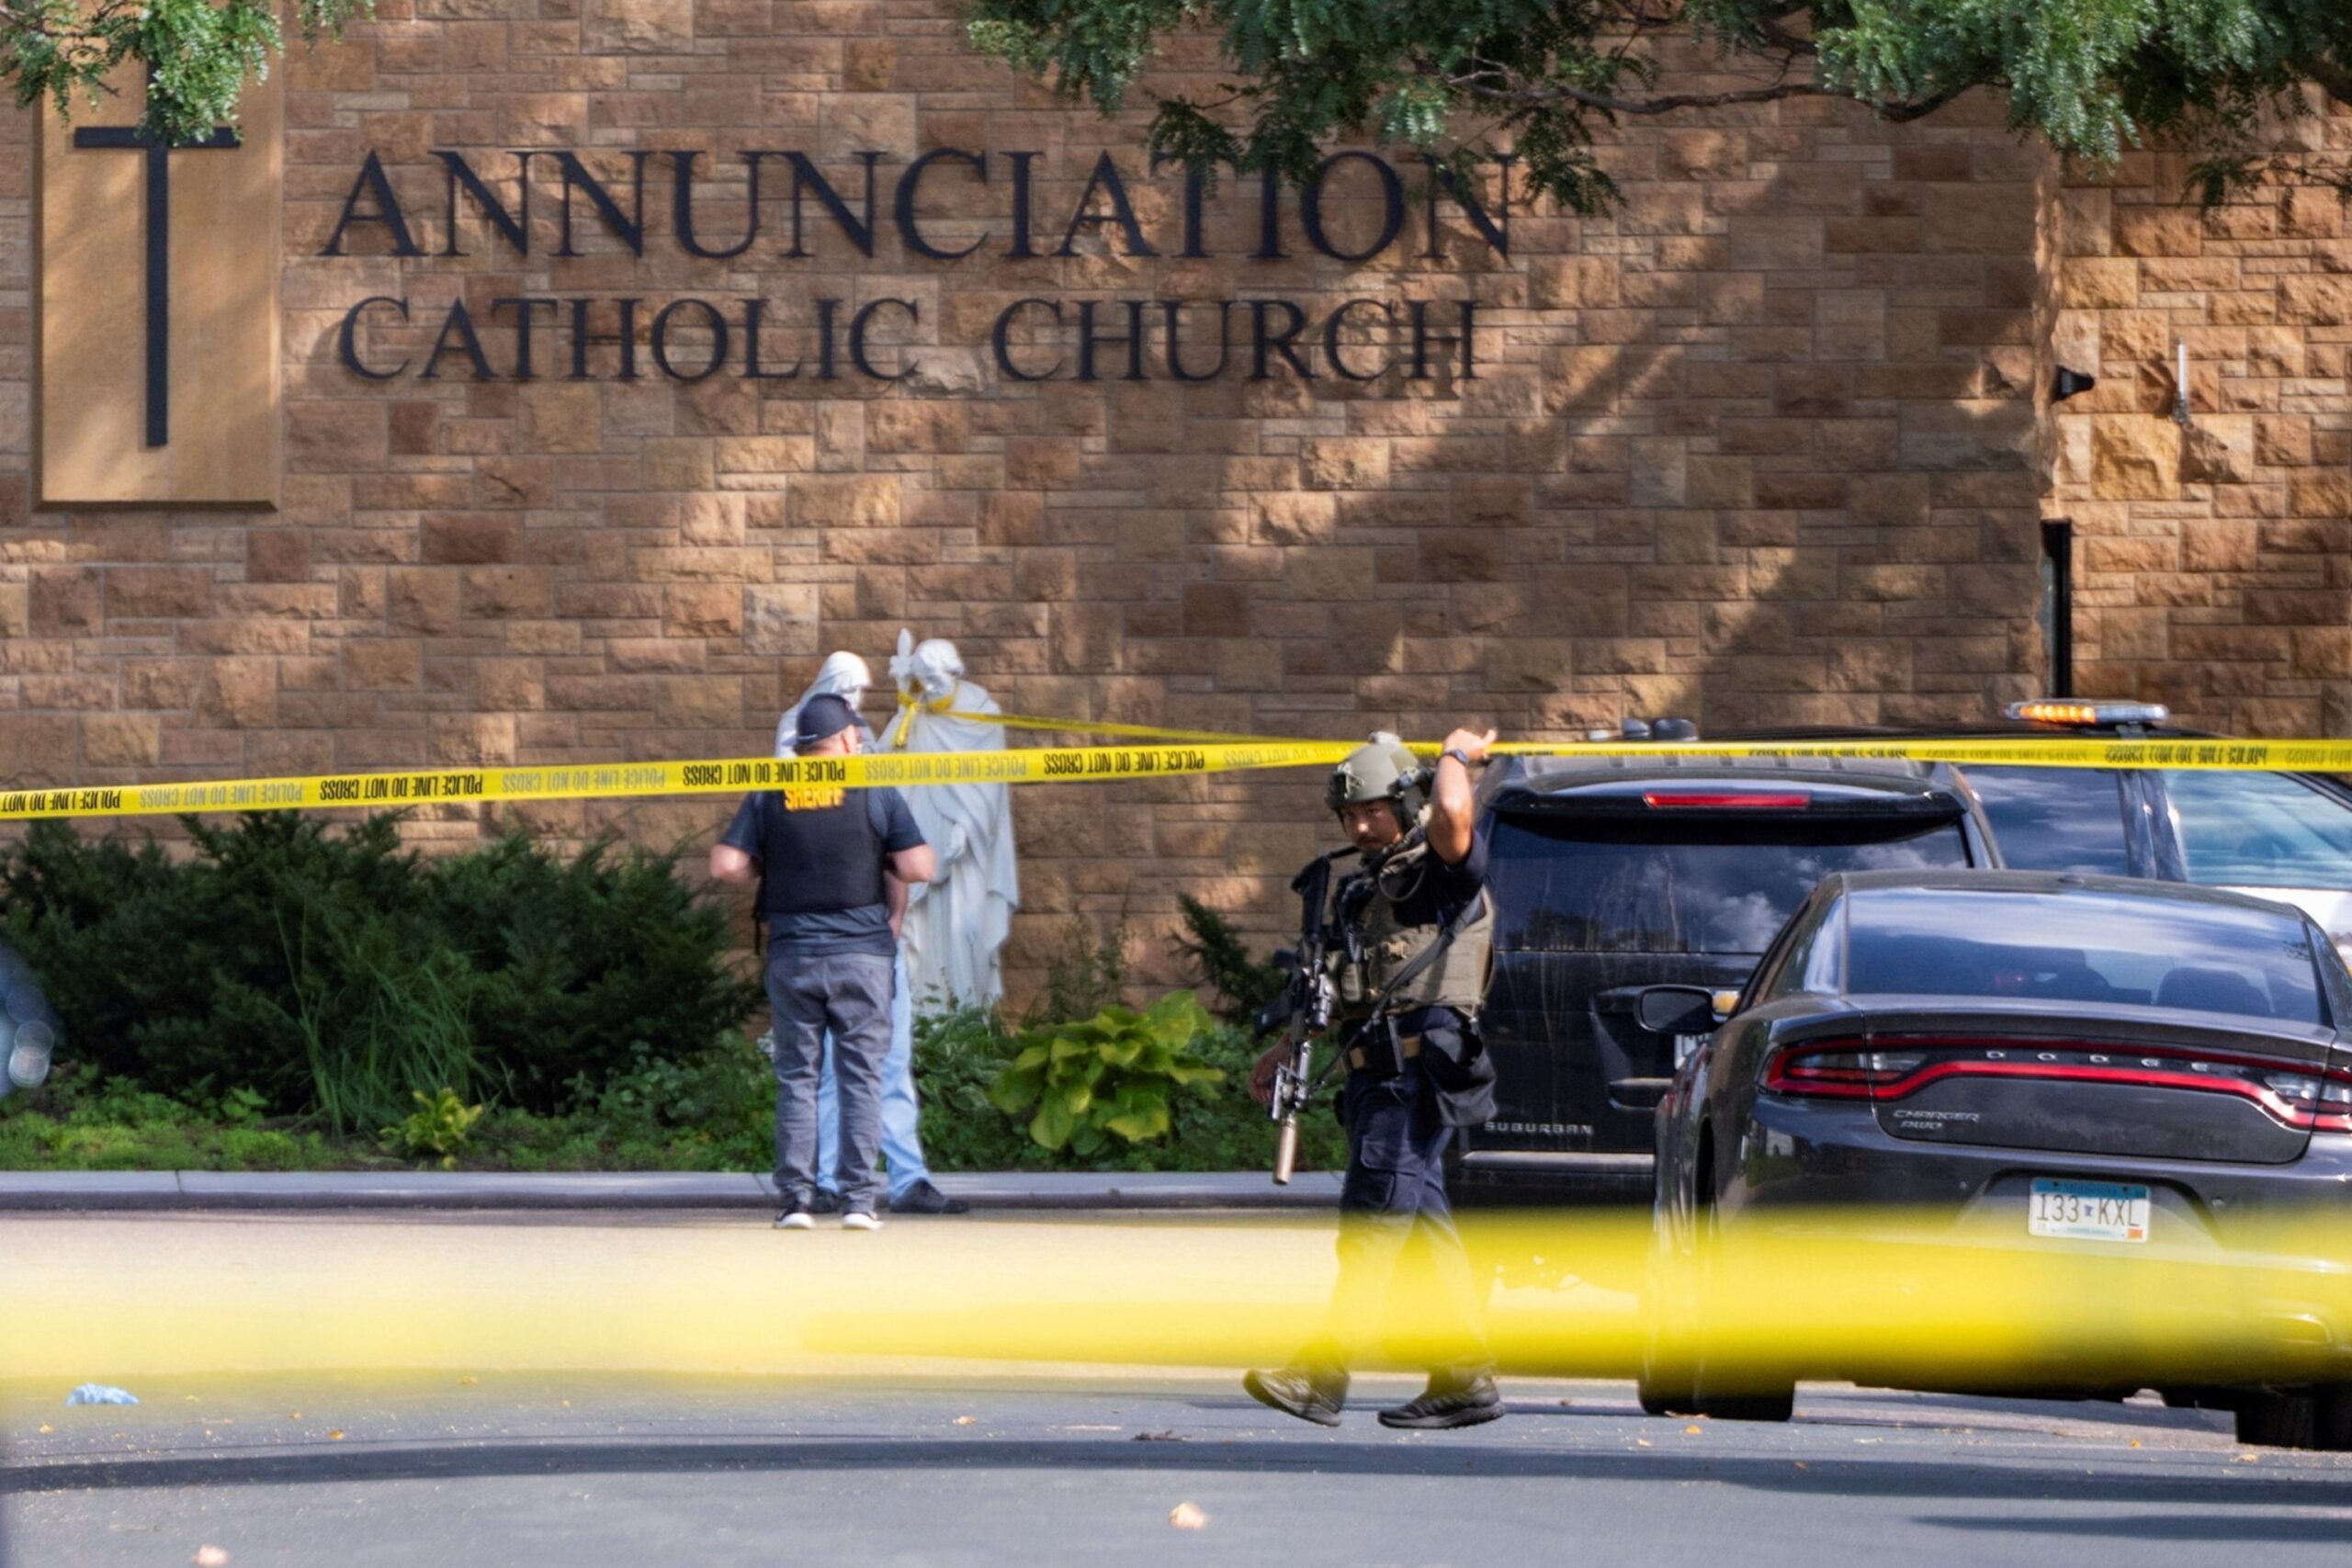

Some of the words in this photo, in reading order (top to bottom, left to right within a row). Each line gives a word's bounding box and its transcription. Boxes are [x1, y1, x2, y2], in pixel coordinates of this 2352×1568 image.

[316, 147, 1515, 263] ANNUNCIATION
[338, 296, 919, 382] CATHOLIC
[992, 297, 1485, 382] CHURCH
[909, 760, 930, 779] NOT
[935, 759, 952, 778] DO
[956, 758, 980, 777] LINE
[985, 755, 1026, 776] POLICE
[1044, 753, 1083, 774] CROSS
[1088, 753, 1111, 773] NOT
[1115, 752, 1130, 772] DO
[1134, 751, 1160, 772] LINE
[1164, 750, 1204, 771] POLICE
[683, 764, 722, 786] CROSS
[727, 764, 750, 784] NOT
[755, 763, 770, 783] DO
[774, 761, 800, 783] LINE
[805, 761, 845, 783] POLICE
[865, 761, 904, 781] CROSS
[231, 784, 257, 805] LINE
[261, 784, 303, 803] POLICE
[320, 780, 359, 801] CROSS
[365, 779, 388, 799] NOT
[392, 778, 408, 797] DO
[412, 776, 438, 797] LINE
[442, 774, 483, 795] POLICE
[1, 794, 26, 812] NOT
[30, 794, 46, 811] DO
[50, 792, 76, 810] LINE
[80, 790, 121, 809] POLICE
[140, 789, 179, 807] CROSS
[184, 788, 206, 807] NOT
[210, 786, 226, 806] DO
[785, 788, 844, 812] SHERIFF
[1986, 1050, 2208, 1072] DODGE
[1893, 1110, 1980, 1122] CHARGER
[1484, 1121, 1594, 1135] SUBURBAN
[2037, 1193, 2079, 1223] 133
[2098, 1197, 2140, 1226] KXL
